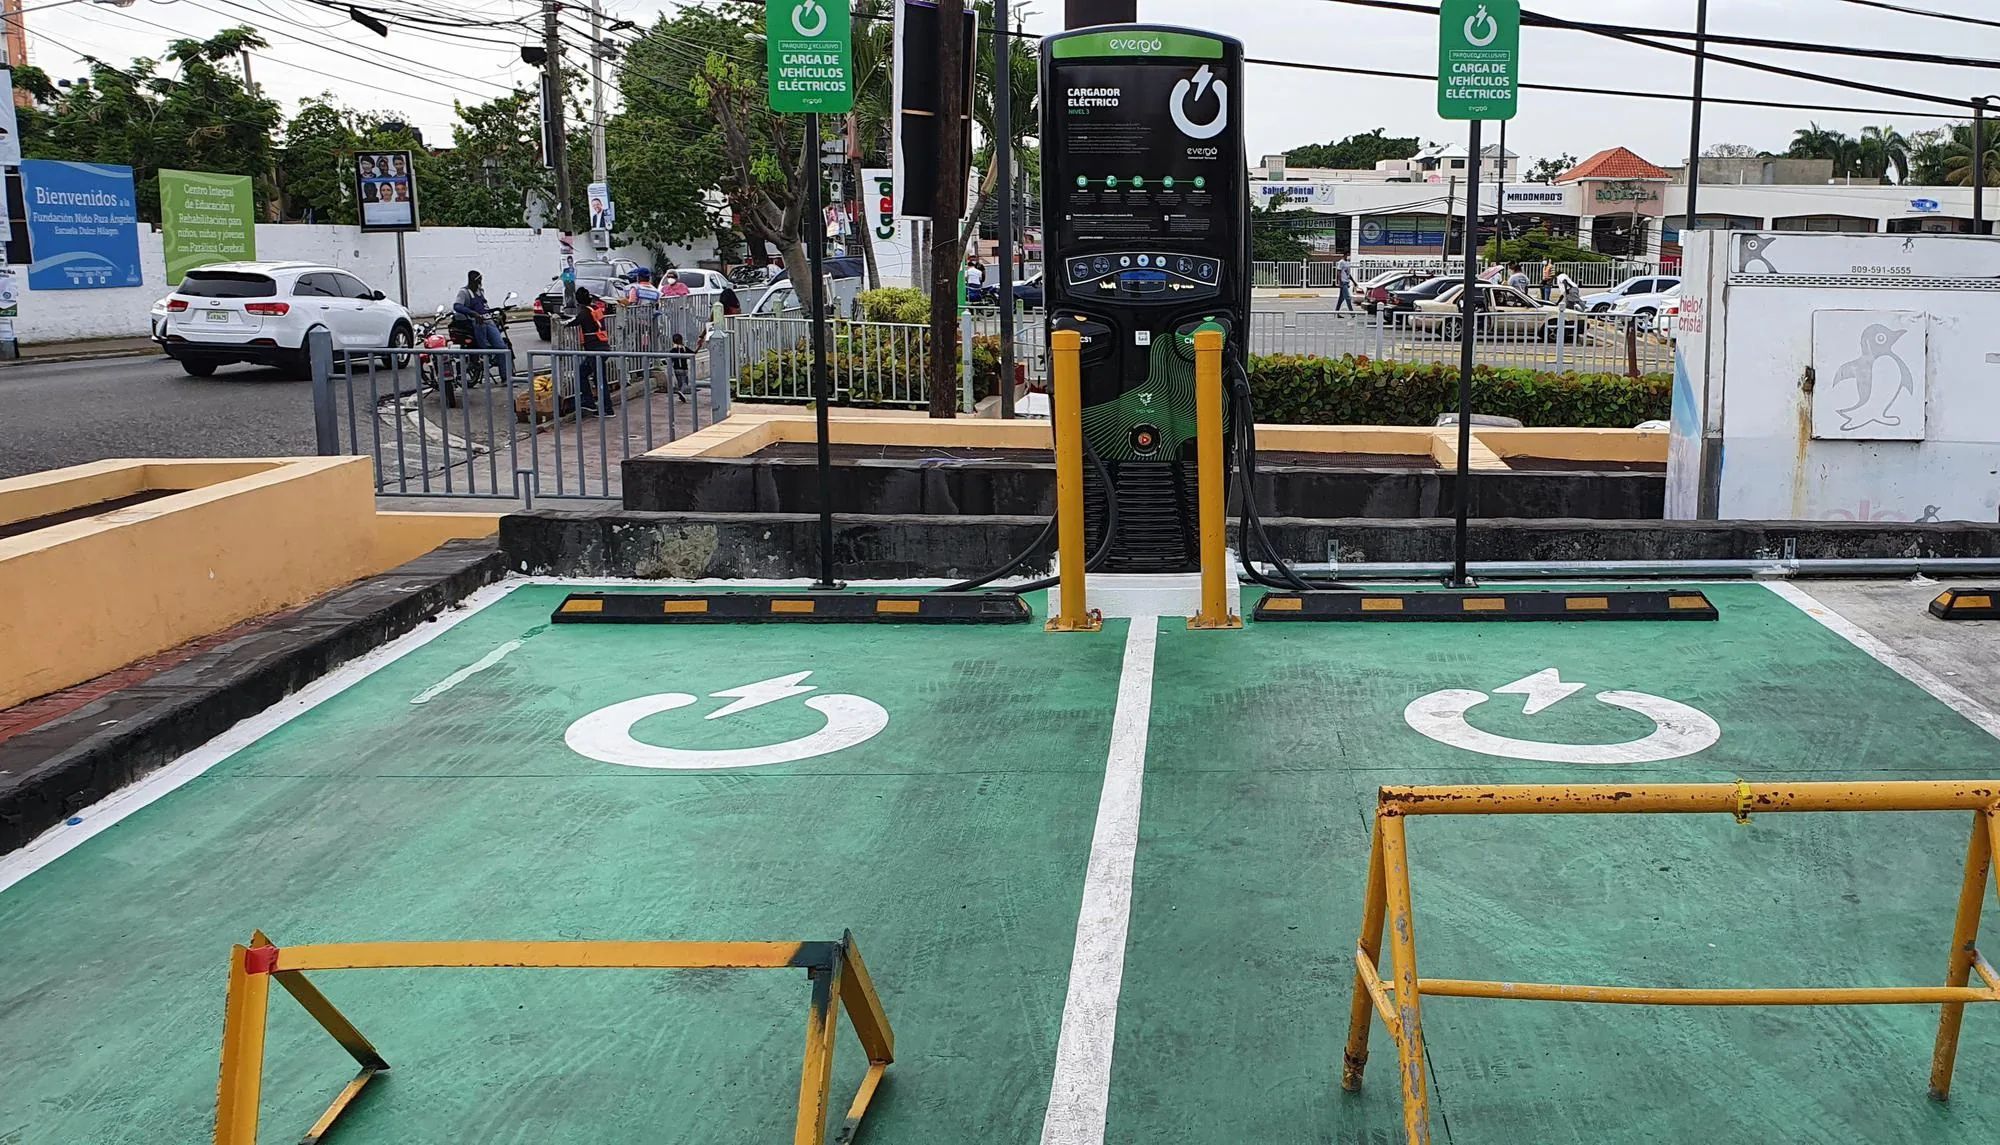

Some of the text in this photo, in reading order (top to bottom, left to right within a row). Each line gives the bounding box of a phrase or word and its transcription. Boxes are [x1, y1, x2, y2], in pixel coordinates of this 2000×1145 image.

[1109, 37, 1162, 53] evergo
[782, 54, 839, 65] CARGA DE
[779, 65, 844, 78] VEHÍCULOS
[1452, 63, 1507, 74] CARGA DE
[777, 78, 846, 91] ELÉCTRICOS
[1448, 74, 1510, 86] VEHÍCULOS
[1067, 88, 1121, 97] CARGADOR
[1446, 86, 1512, 99] ELÉCTRICOS
[1067, 96, 1119, 107] ELÉCTRICO
[1186, 146, 1218, 157] evergo
[183, 184, 234, 198] Centro Integral
[1288, 186, 1314, 195] Dental
[35, 187, 118, 206] Bienvenidos
[1507, 193, 1563, 201] MALDONADO'S
[184, 199, 195, 209] de
[230, 203, 235, 213] y
[33, 212, 74, 223] Fundación
[75, 213, 93, 223] Nido
[1308, 219, 1335, 228] Dental
[1851, 265, 1912, 274] 809-591-5555
[1680, 294, 1699, 314] hielo
[1678, 314, 1704, 333] cristal
